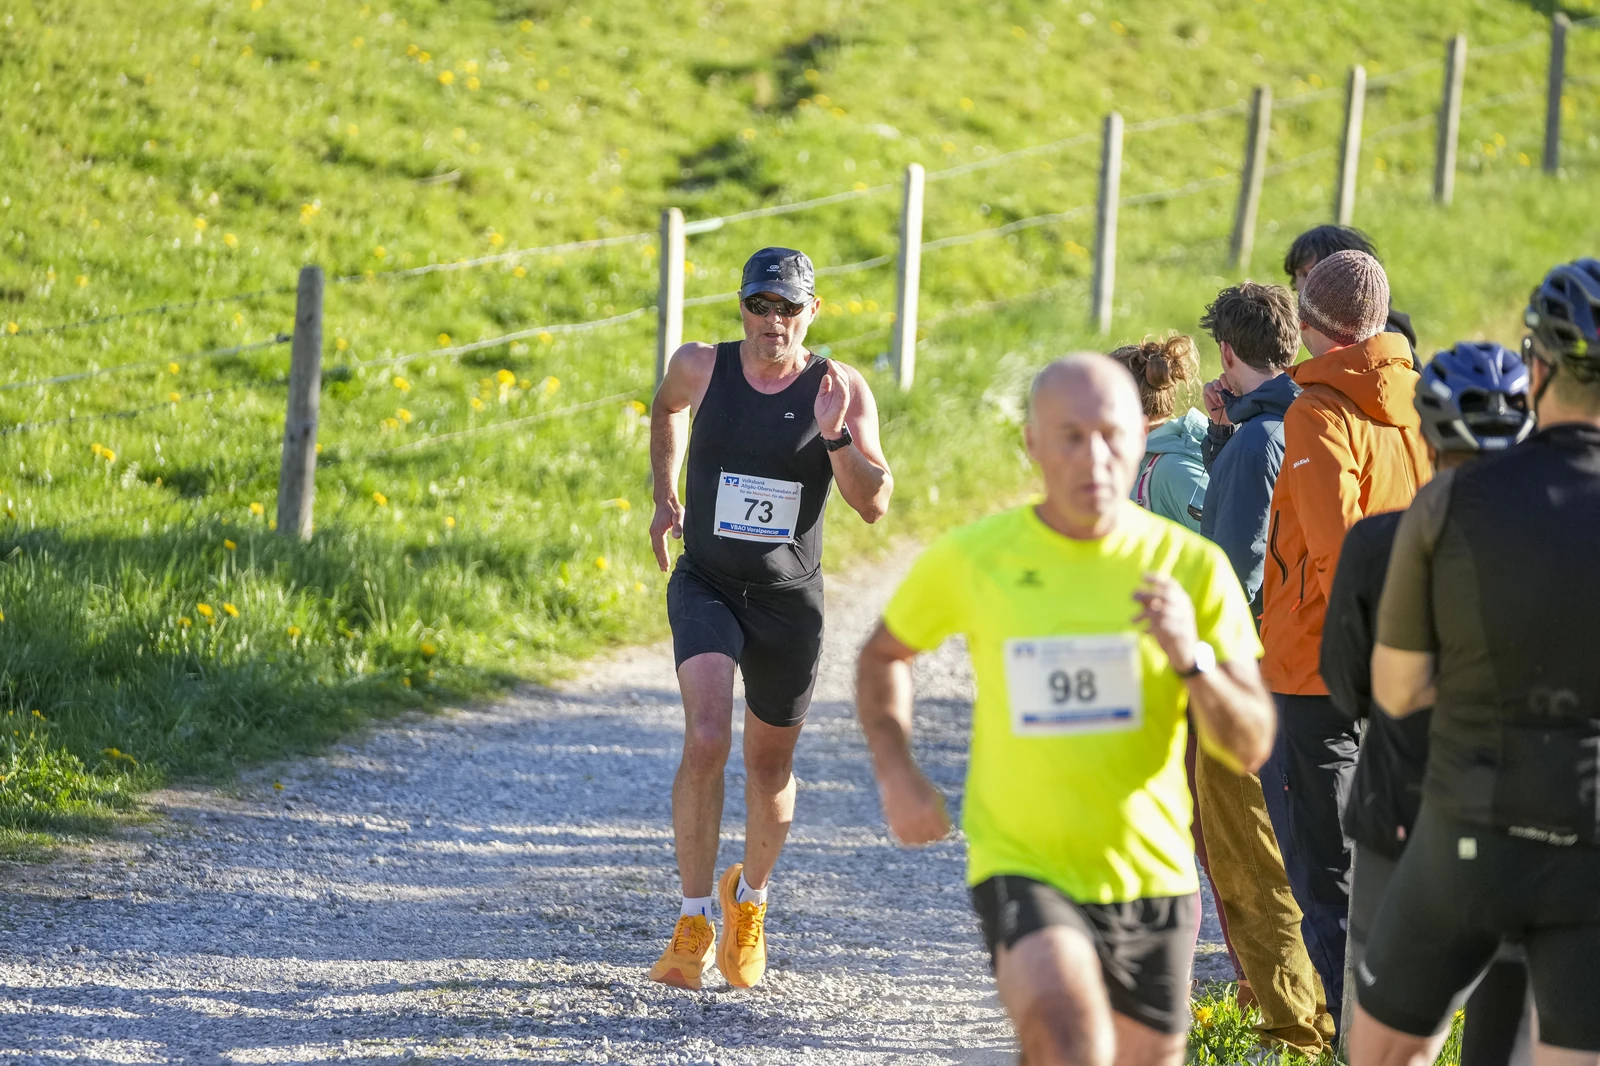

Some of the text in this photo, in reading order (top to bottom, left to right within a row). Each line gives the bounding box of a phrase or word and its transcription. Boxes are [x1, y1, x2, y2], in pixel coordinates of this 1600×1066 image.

[744, 497, 774, 524] 73
[730, 523, 779, 535] VBAO Voralpencup
[1048, 667, 1098, 706] 98
